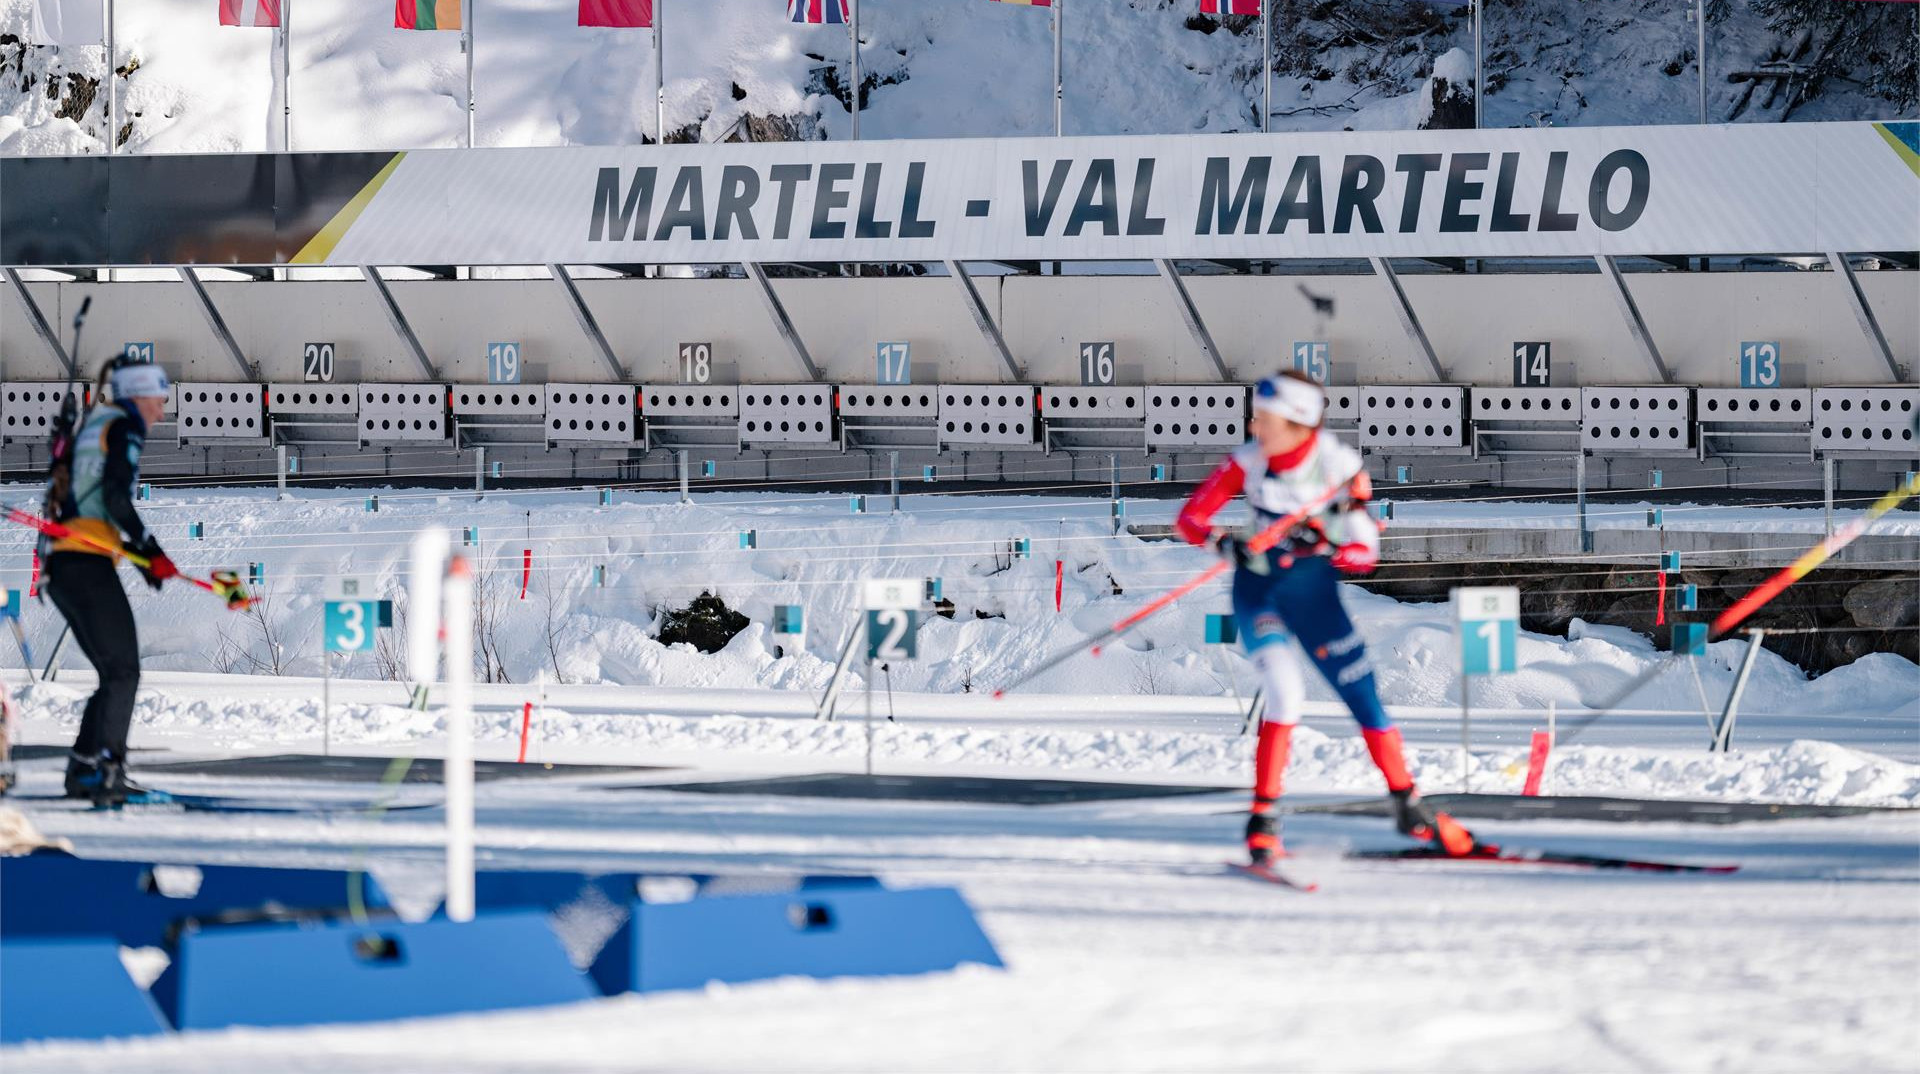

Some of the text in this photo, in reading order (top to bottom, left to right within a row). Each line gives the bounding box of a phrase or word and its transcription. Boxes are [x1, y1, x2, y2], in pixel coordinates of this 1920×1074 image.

[588, 148, 1651, 242] MARTELL - VAL MARTELLO
[304, 344, 334, 382] 20
[491, 344, 517, 382] 19
[681, 344, 710, 383] 18
[880, 344, 908, 382] 17
[1082, 344, 1113, 384] 16
[1297, 343, 1327, 384] 15
[1515, 344, 1548, 385] 14
[1744, 344, 1778, 385] 13
[336, 602, 365, 651] 3
[876, 609, 908, 659] 2
[1476, 620, 1500, 670] 1
